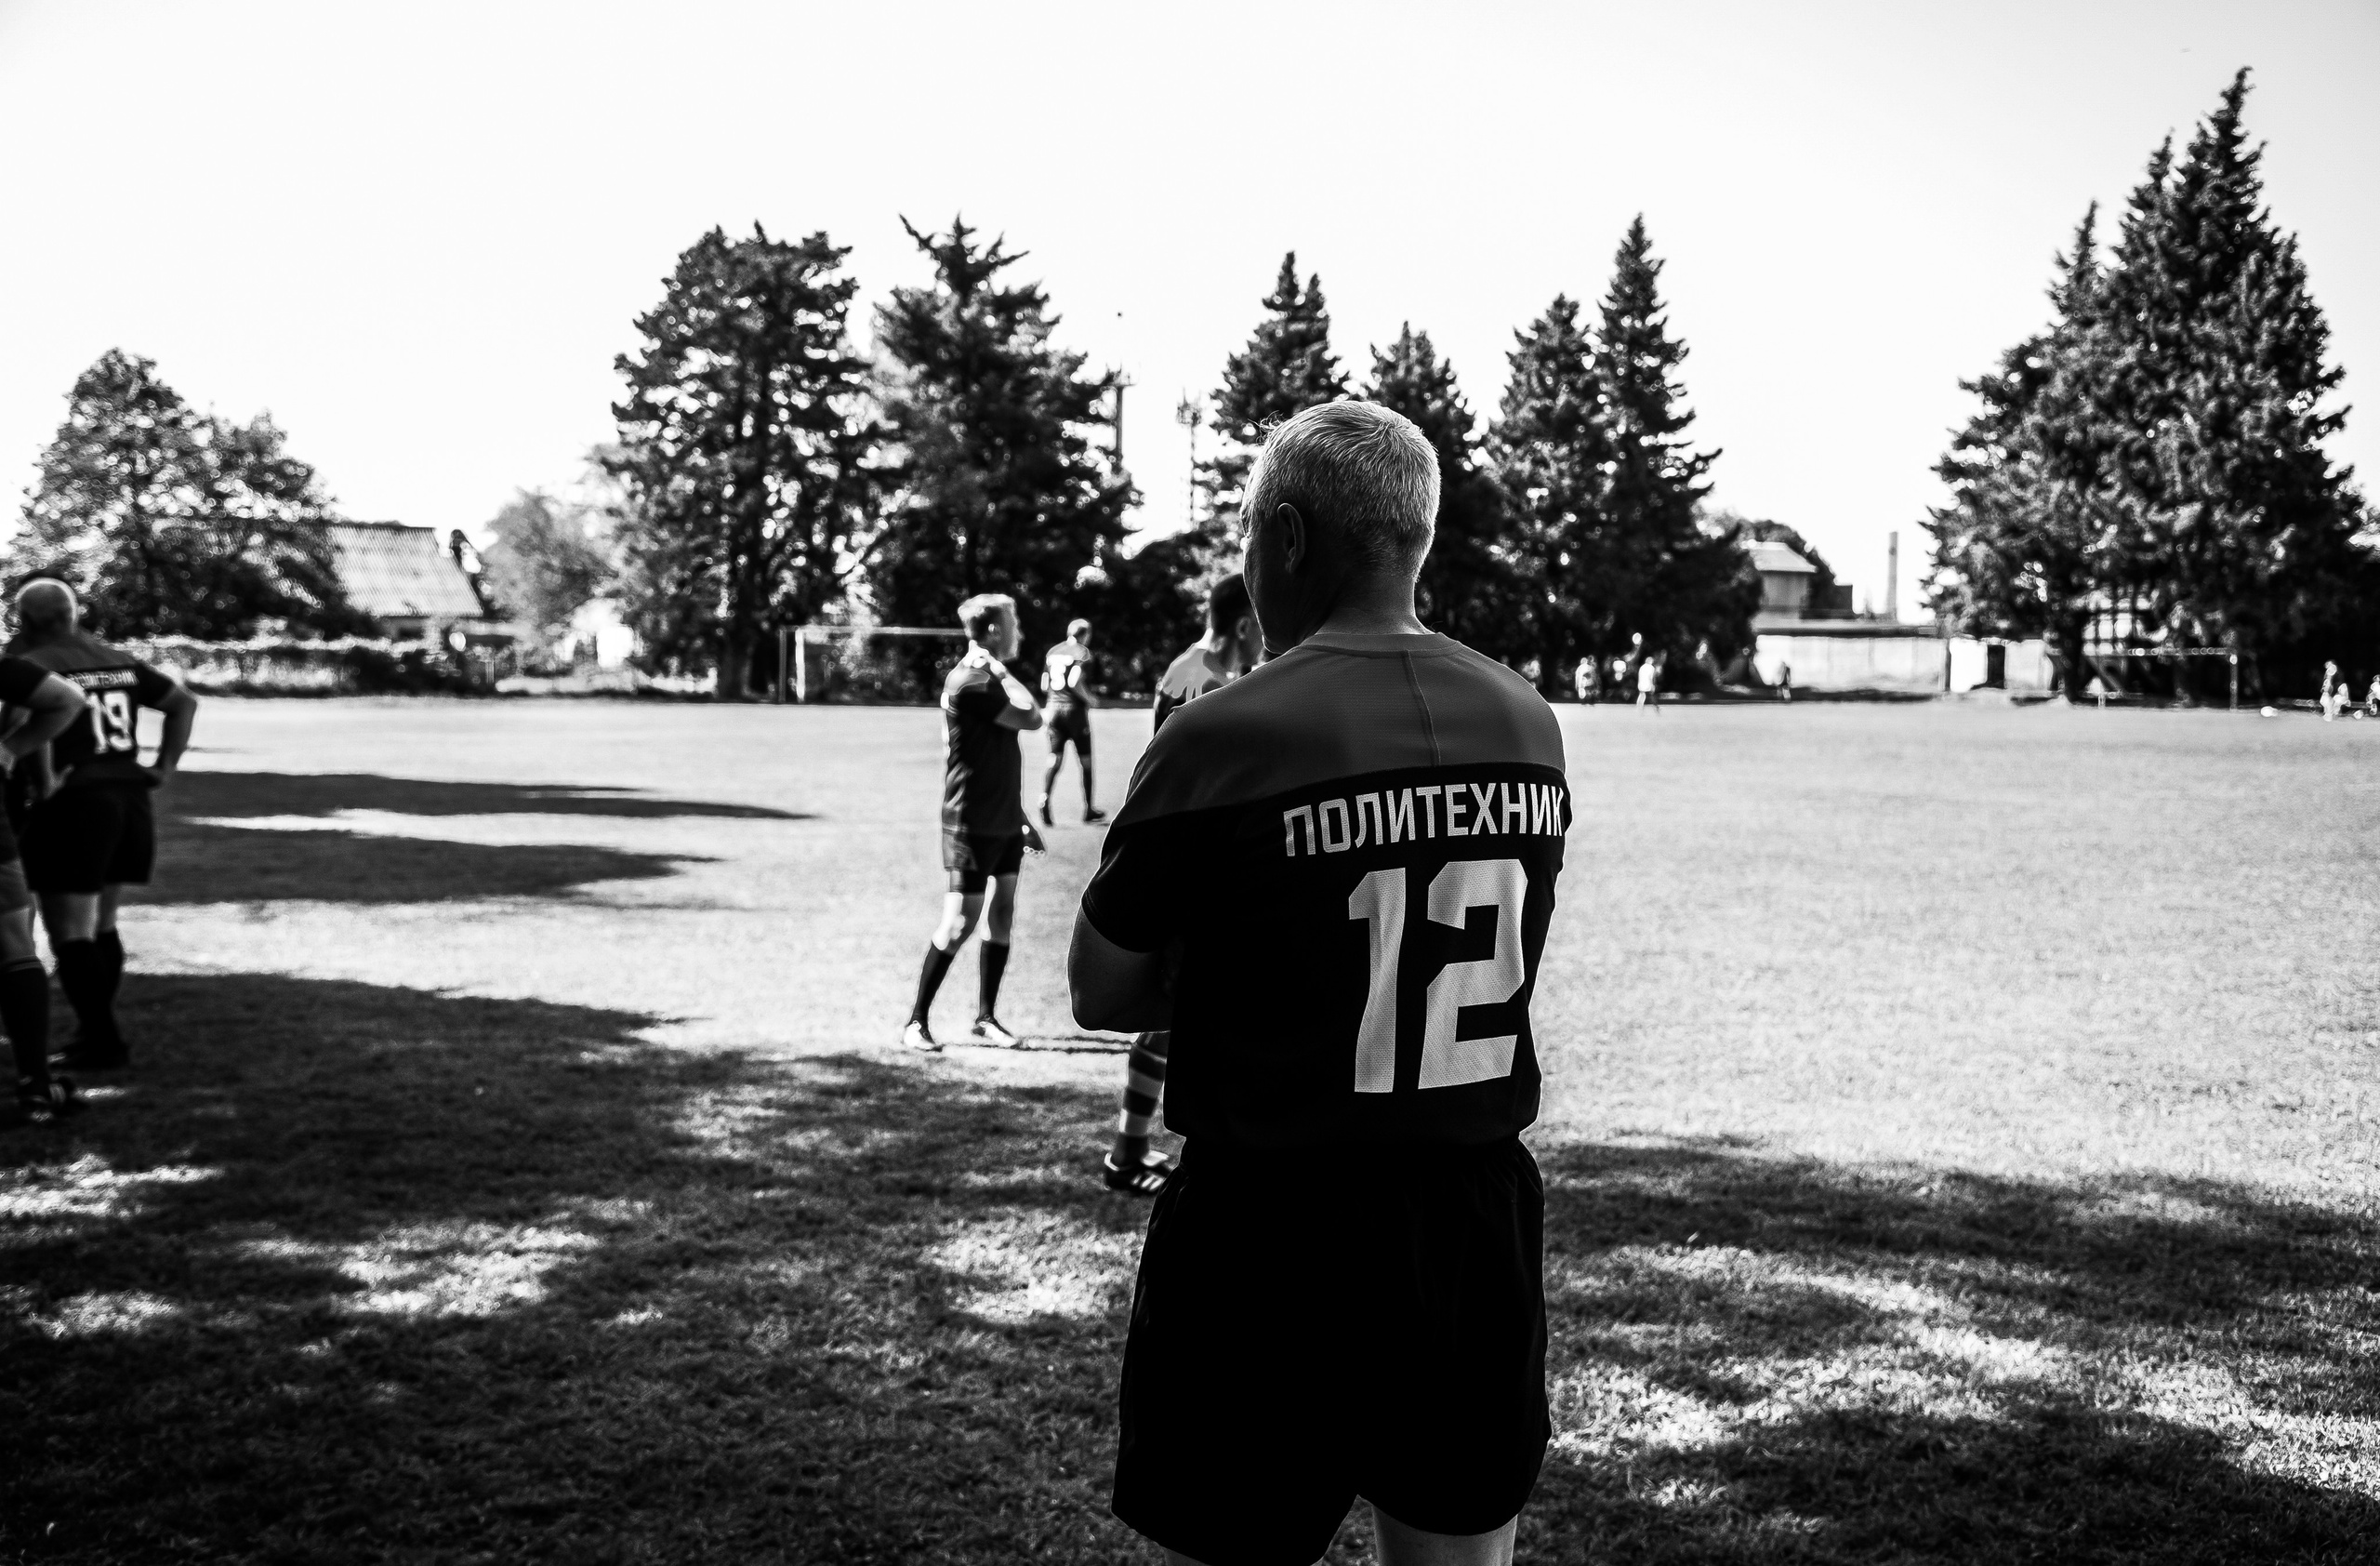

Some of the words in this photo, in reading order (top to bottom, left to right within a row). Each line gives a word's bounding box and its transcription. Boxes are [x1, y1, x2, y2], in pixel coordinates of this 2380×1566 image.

[87, 691, 133, 754] 19
[1283, 782, 1564, 856] ПОЛИТЕХНИК
[1348, 858, 1528, 1094] 12
